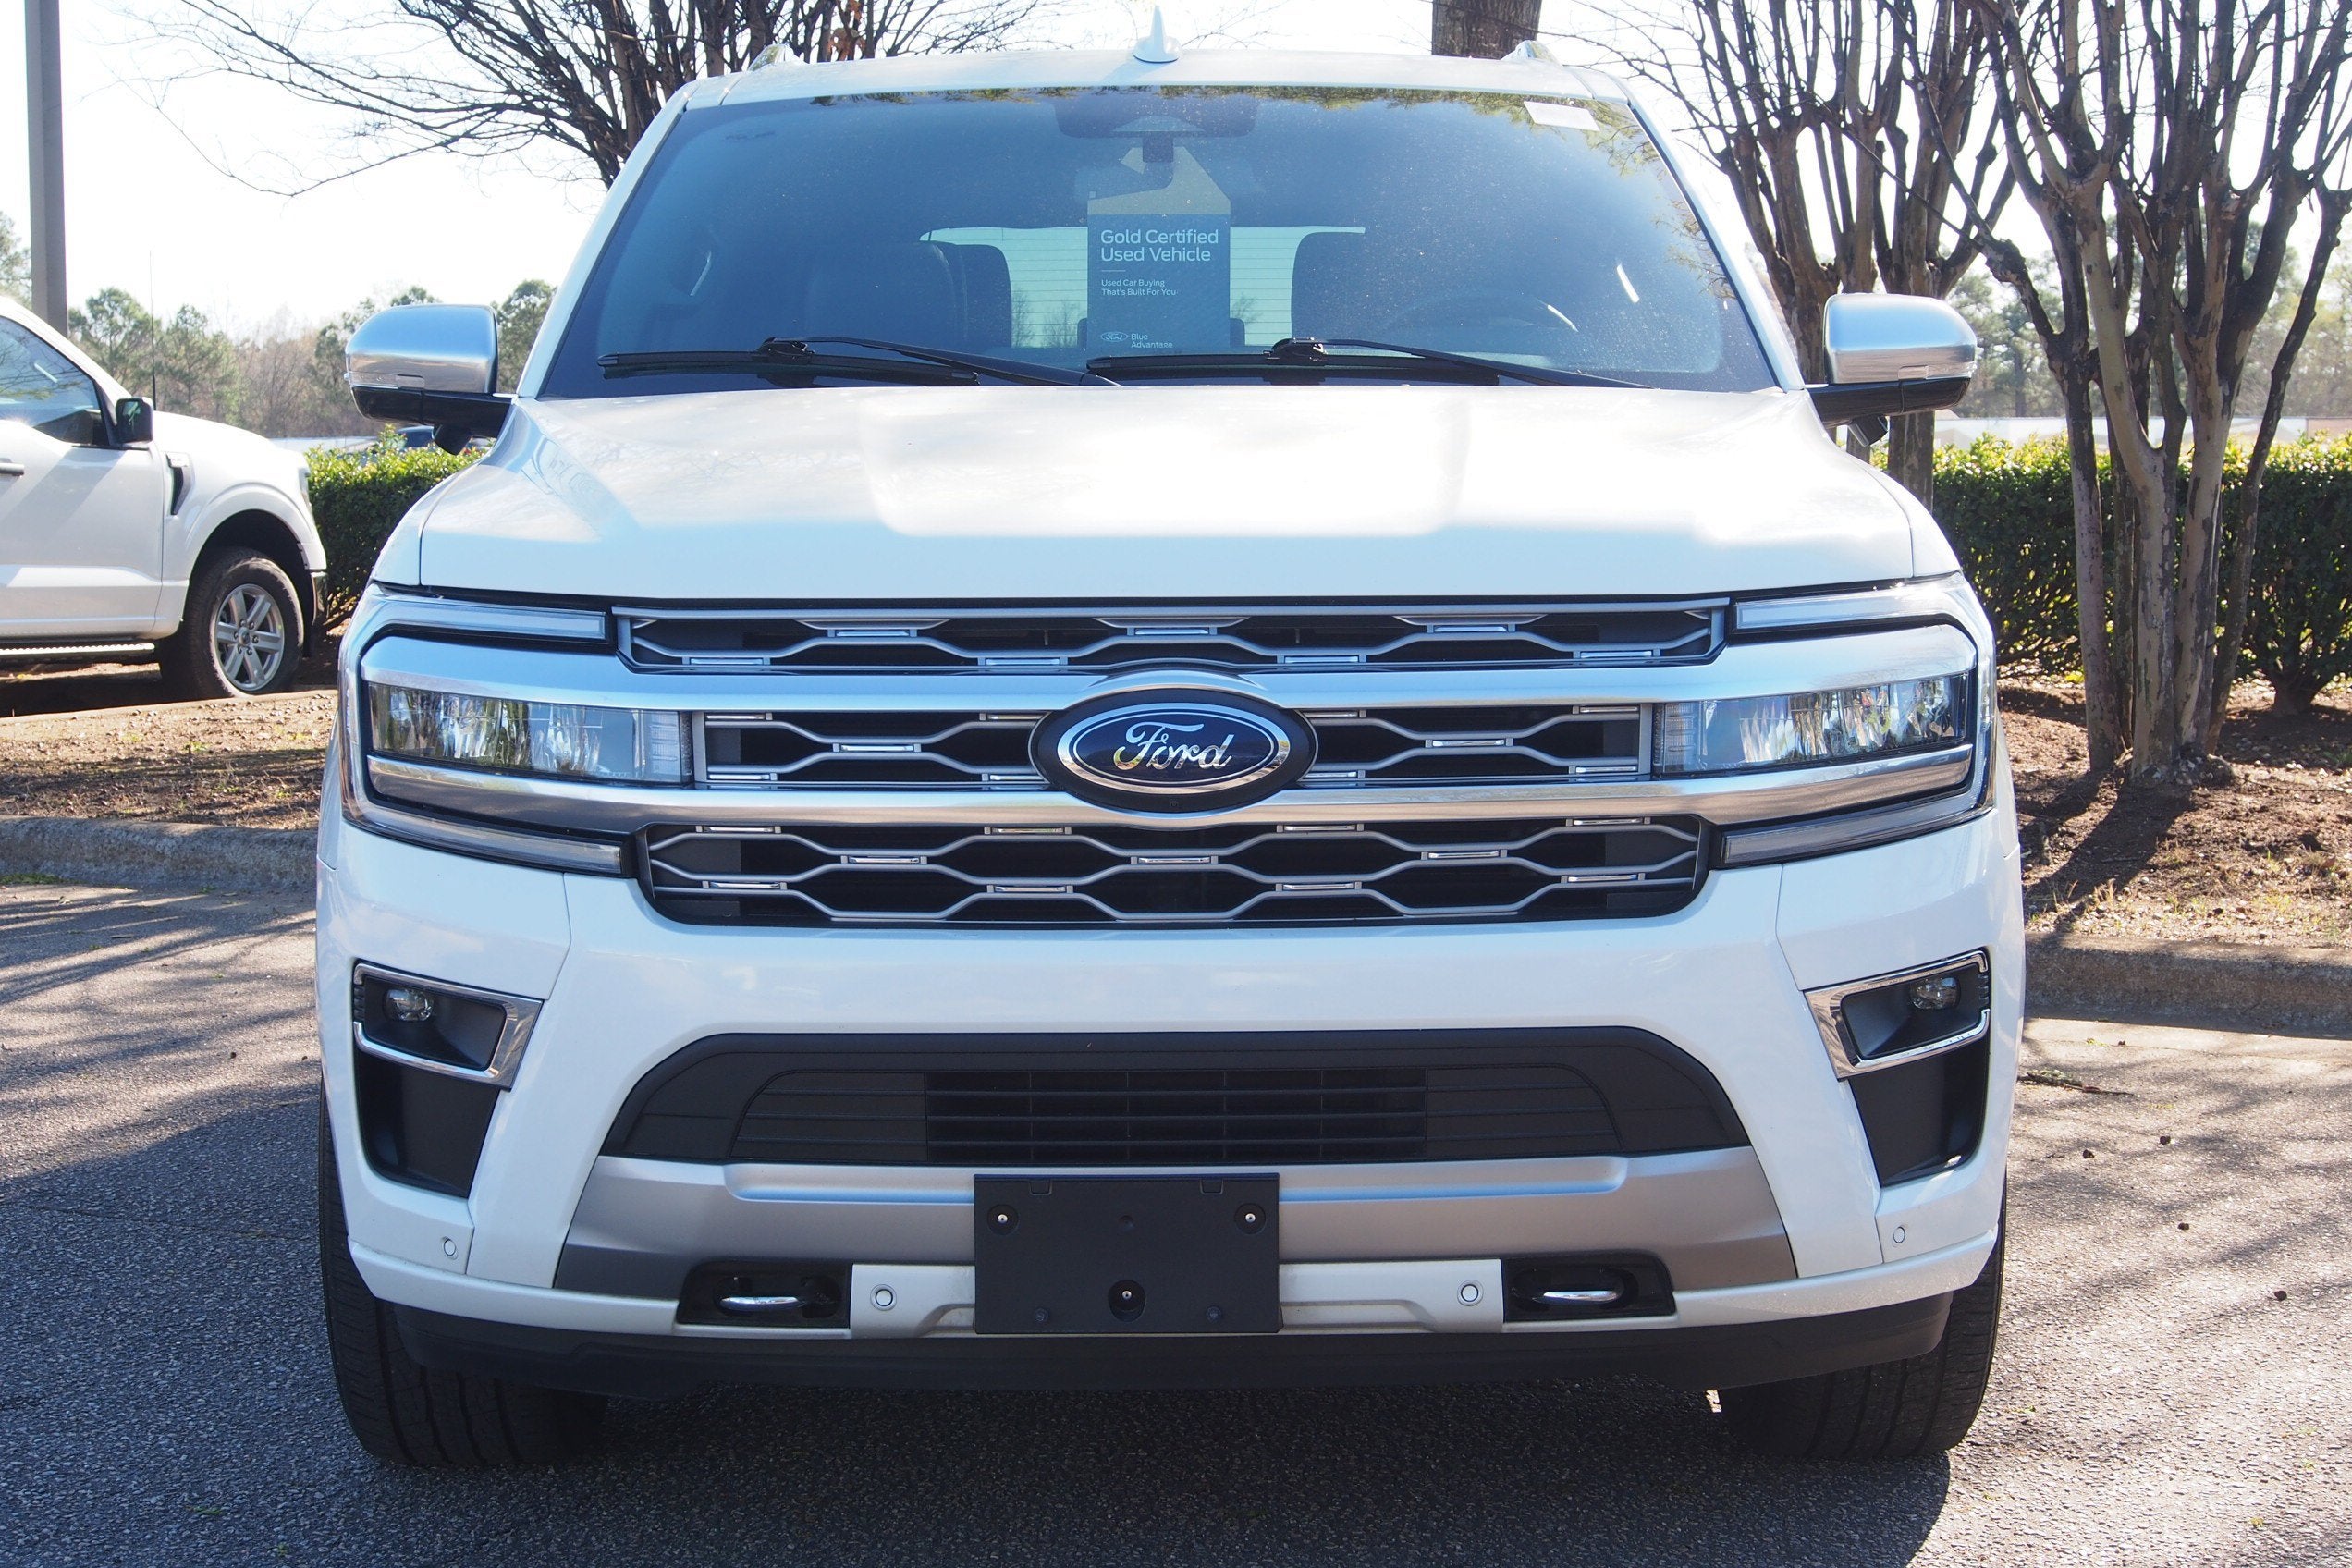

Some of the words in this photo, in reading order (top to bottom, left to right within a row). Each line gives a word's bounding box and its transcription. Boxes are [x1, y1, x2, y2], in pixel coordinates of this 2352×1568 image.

[1100, 229, 1141, 244] Gold
[1145, 229, 1219, 244] Certified
[1101, 247, 1145, 262] Used
[1149, 247, 1211, 262] Vehicle
[1138, 279, 1165, 288] Buying
[1113, 721, 1235, 770] Ford
